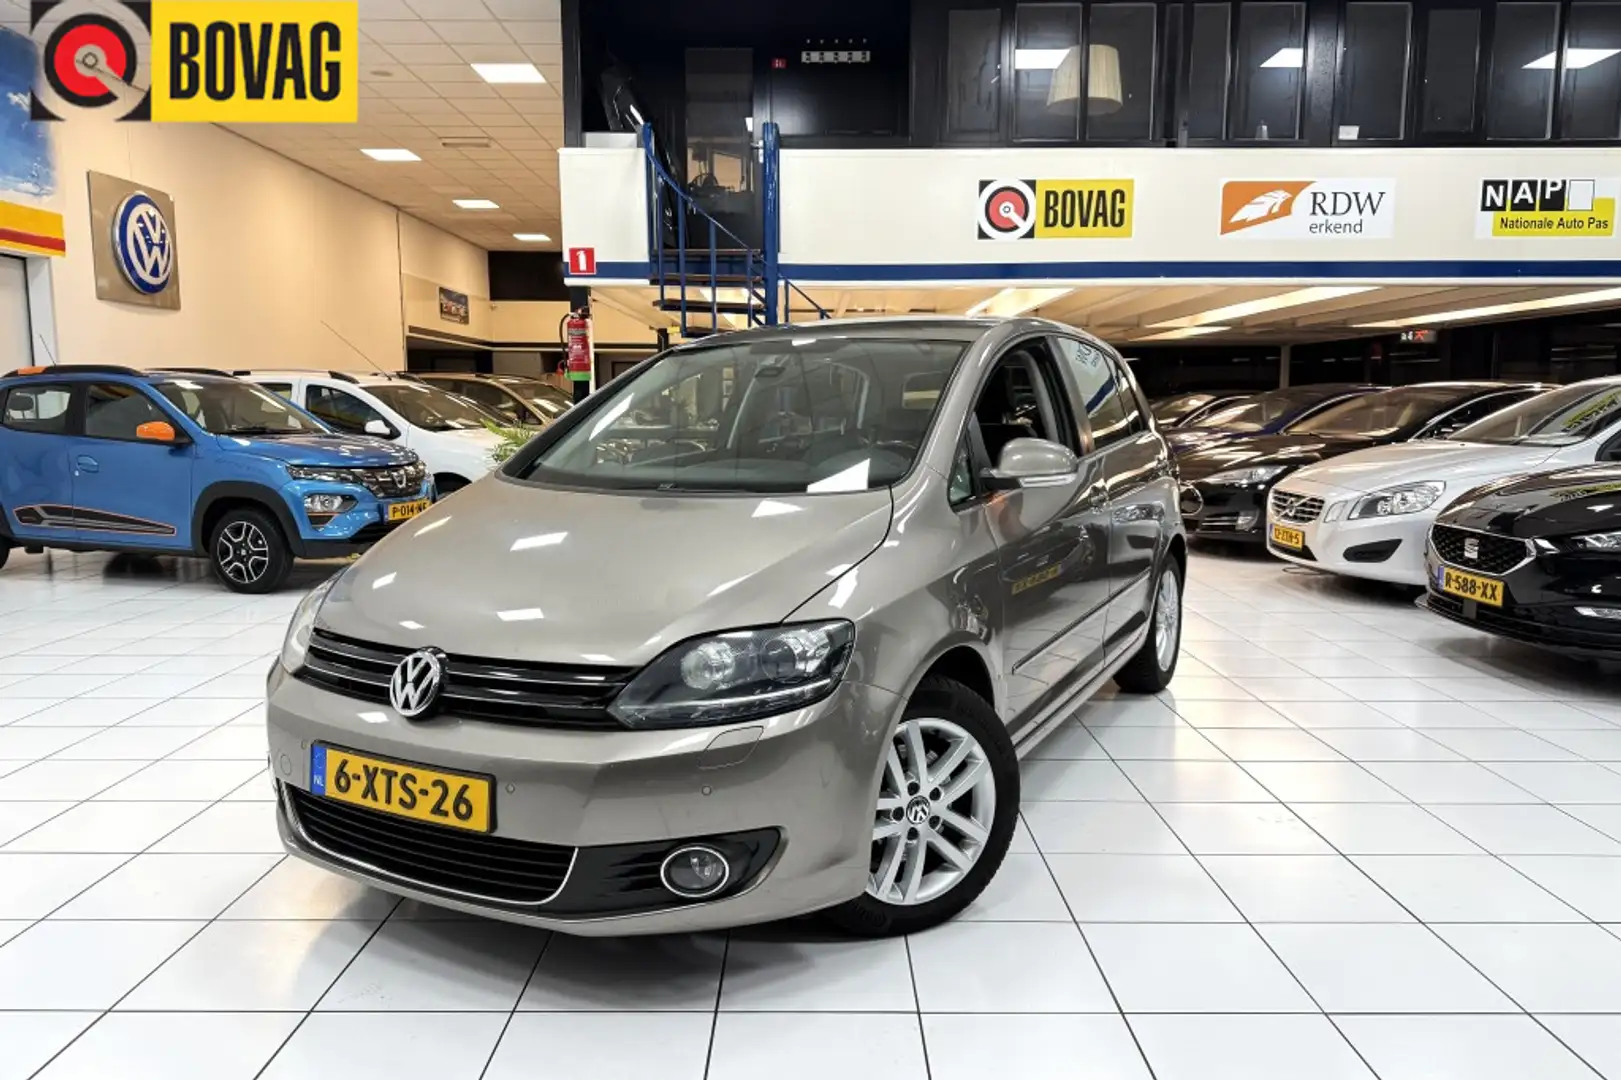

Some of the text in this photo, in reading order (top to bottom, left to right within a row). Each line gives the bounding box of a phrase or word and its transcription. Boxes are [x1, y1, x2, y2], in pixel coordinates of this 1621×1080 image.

[1309, 191, 1386, 216] RDW
[1484, 179, 1563, 207] NAP
[1044, 188, 1125, 228] BOVAG
[1309, 219, 1363, 234] erkend
[1500, 217, 1609, 229] Nationale Auto Pas
[1445, 571, 1498, 601] R-588-XX
[313, 774, 324, 787] NL
[334, 758, 473, 821] 6-XTS-26
